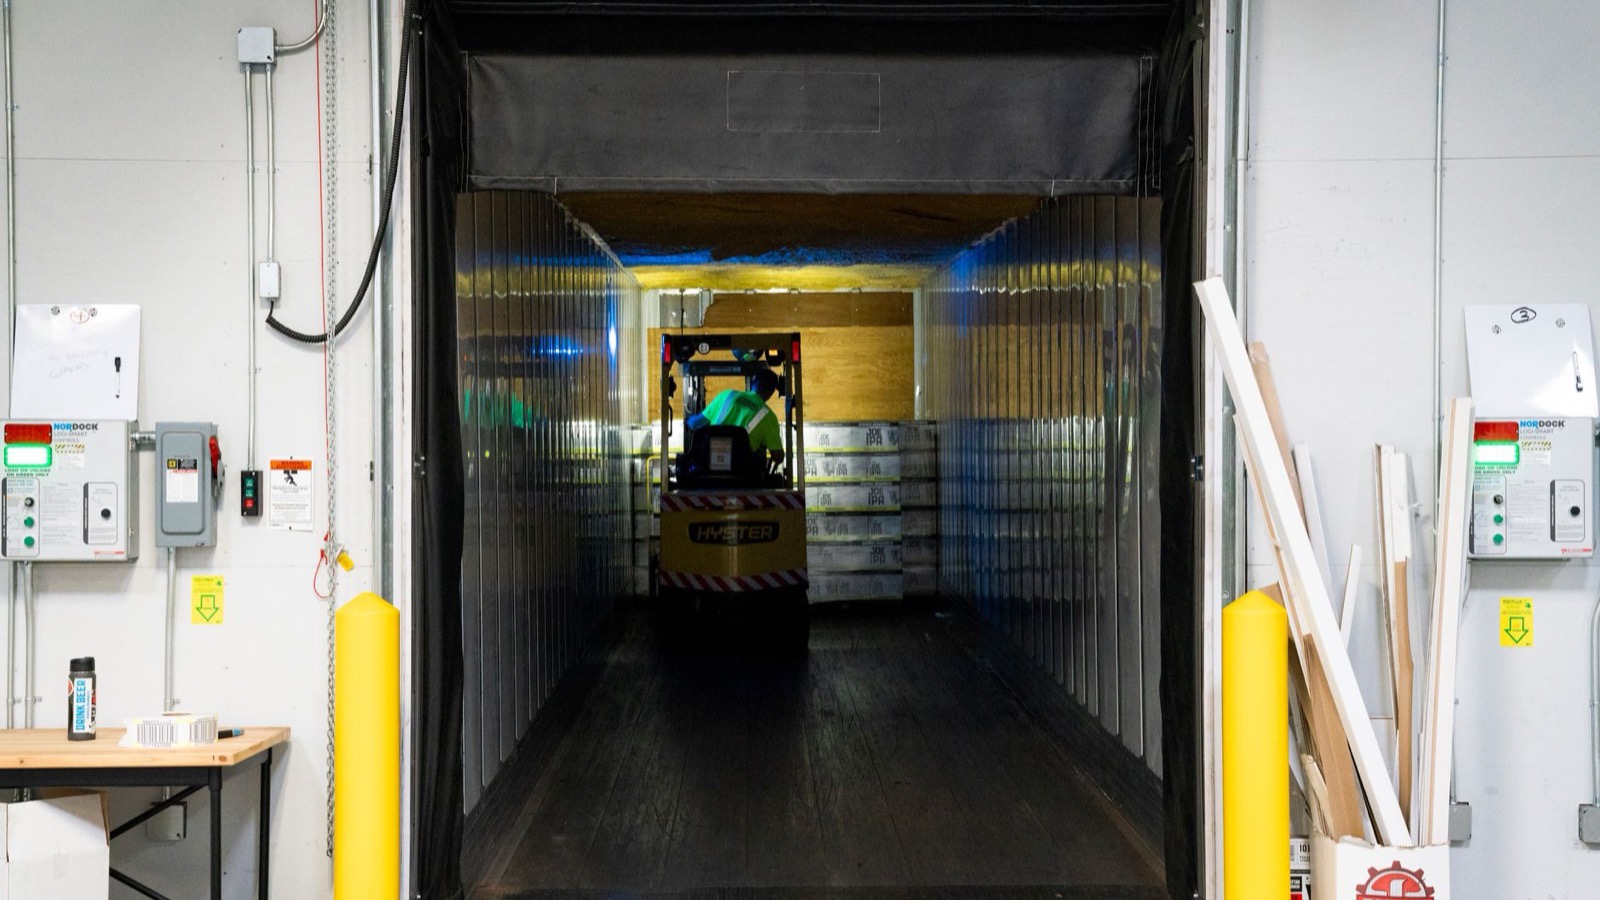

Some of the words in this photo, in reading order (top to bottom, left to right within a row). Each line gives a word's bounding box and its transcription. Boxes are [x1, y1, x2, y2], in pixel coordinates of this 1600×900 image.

[1519, 310, 1530, 322] 3
[53, 422, 98, 431] NORDOCK
[1520, 420, 1565, 429] NORDOCK
[867, 428, 882, 436] JOE
[866, 436, 882, 446] IPA
[868, 487, 884, 495] JOE
[868, 495, 884, 505] IPA
[697, 525, 773, 540] HYSTER
[870, 547, 885, 555] JOE
[869, 555, 885, 564] IPA
[76, 680, 86, 703] BEER
[75, 705, 85, 731] DRINK
